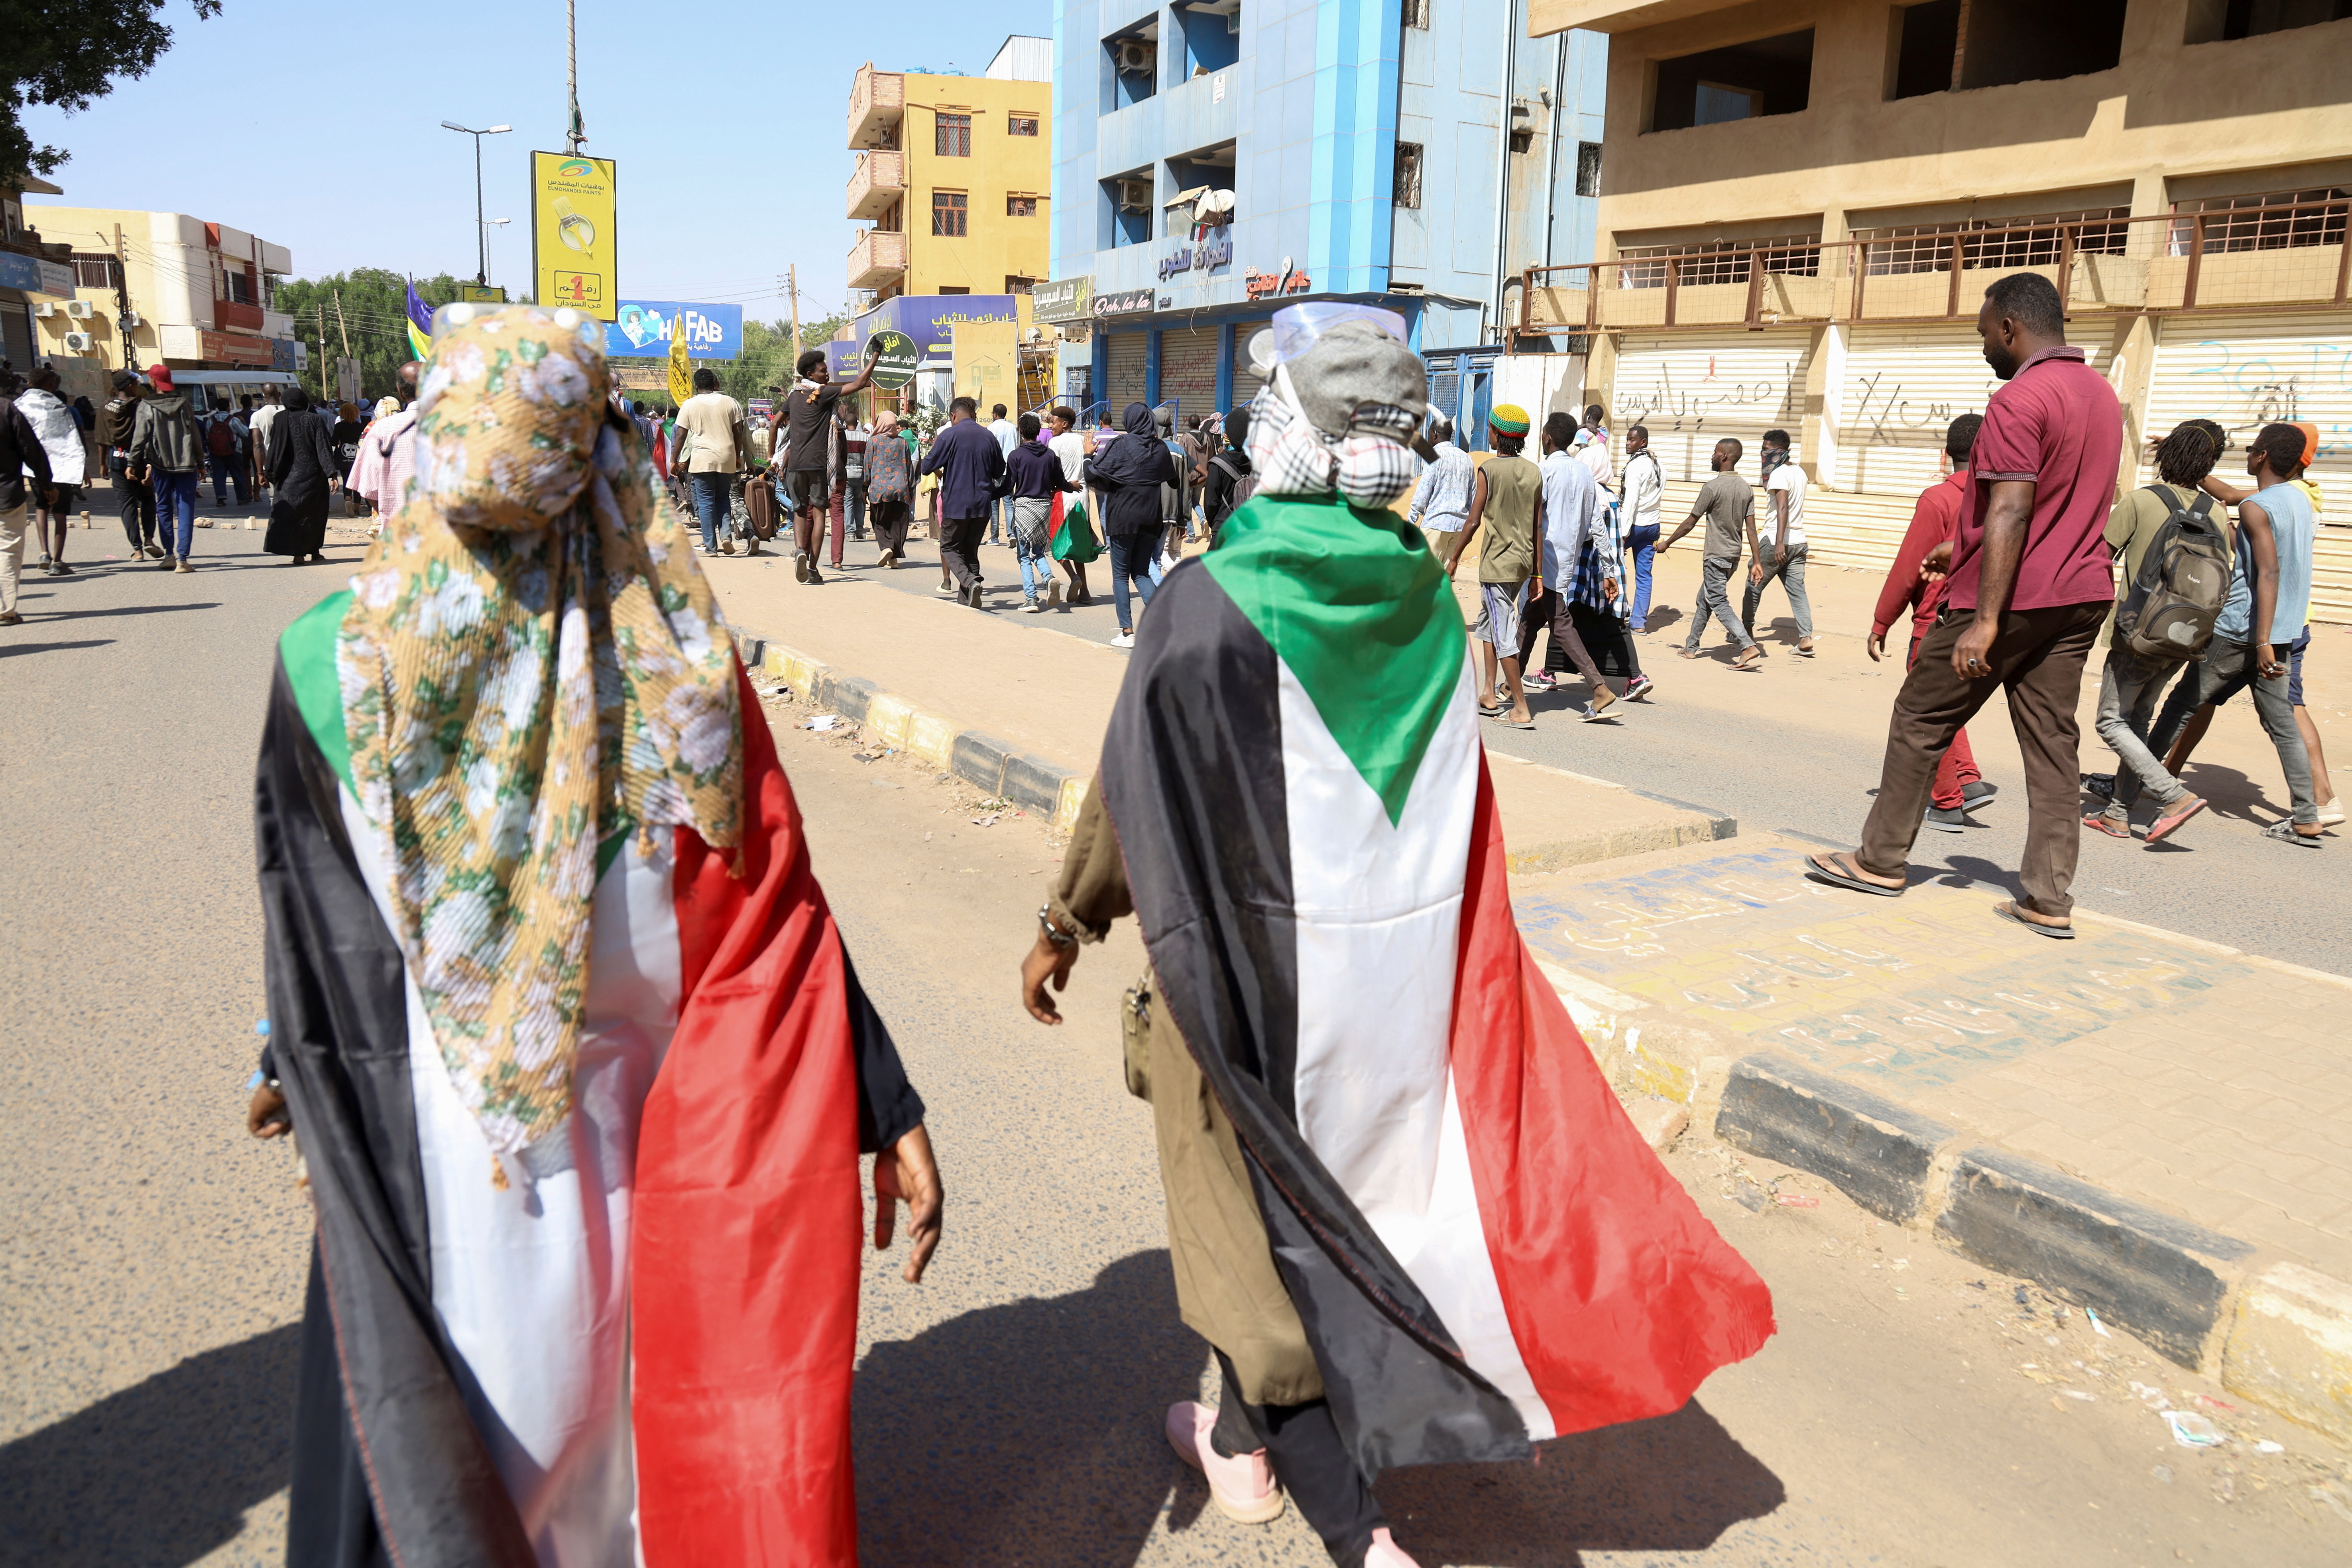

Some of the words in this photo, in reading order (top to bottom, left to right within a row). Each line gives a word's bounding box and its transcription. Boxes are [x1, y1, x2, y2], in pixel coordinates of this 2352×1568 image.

[1094, 297, 1121, 315] Ooh,
[1122, 296, 1135, 311] la
[1136, 294, 1150, 309] la
[694, 343, 712, 352] رفاهية
[883, 335, 900, 352] آفاق
[865, 352, 900, 363] السويسية
[901, 354, 916, 366] للثياب
